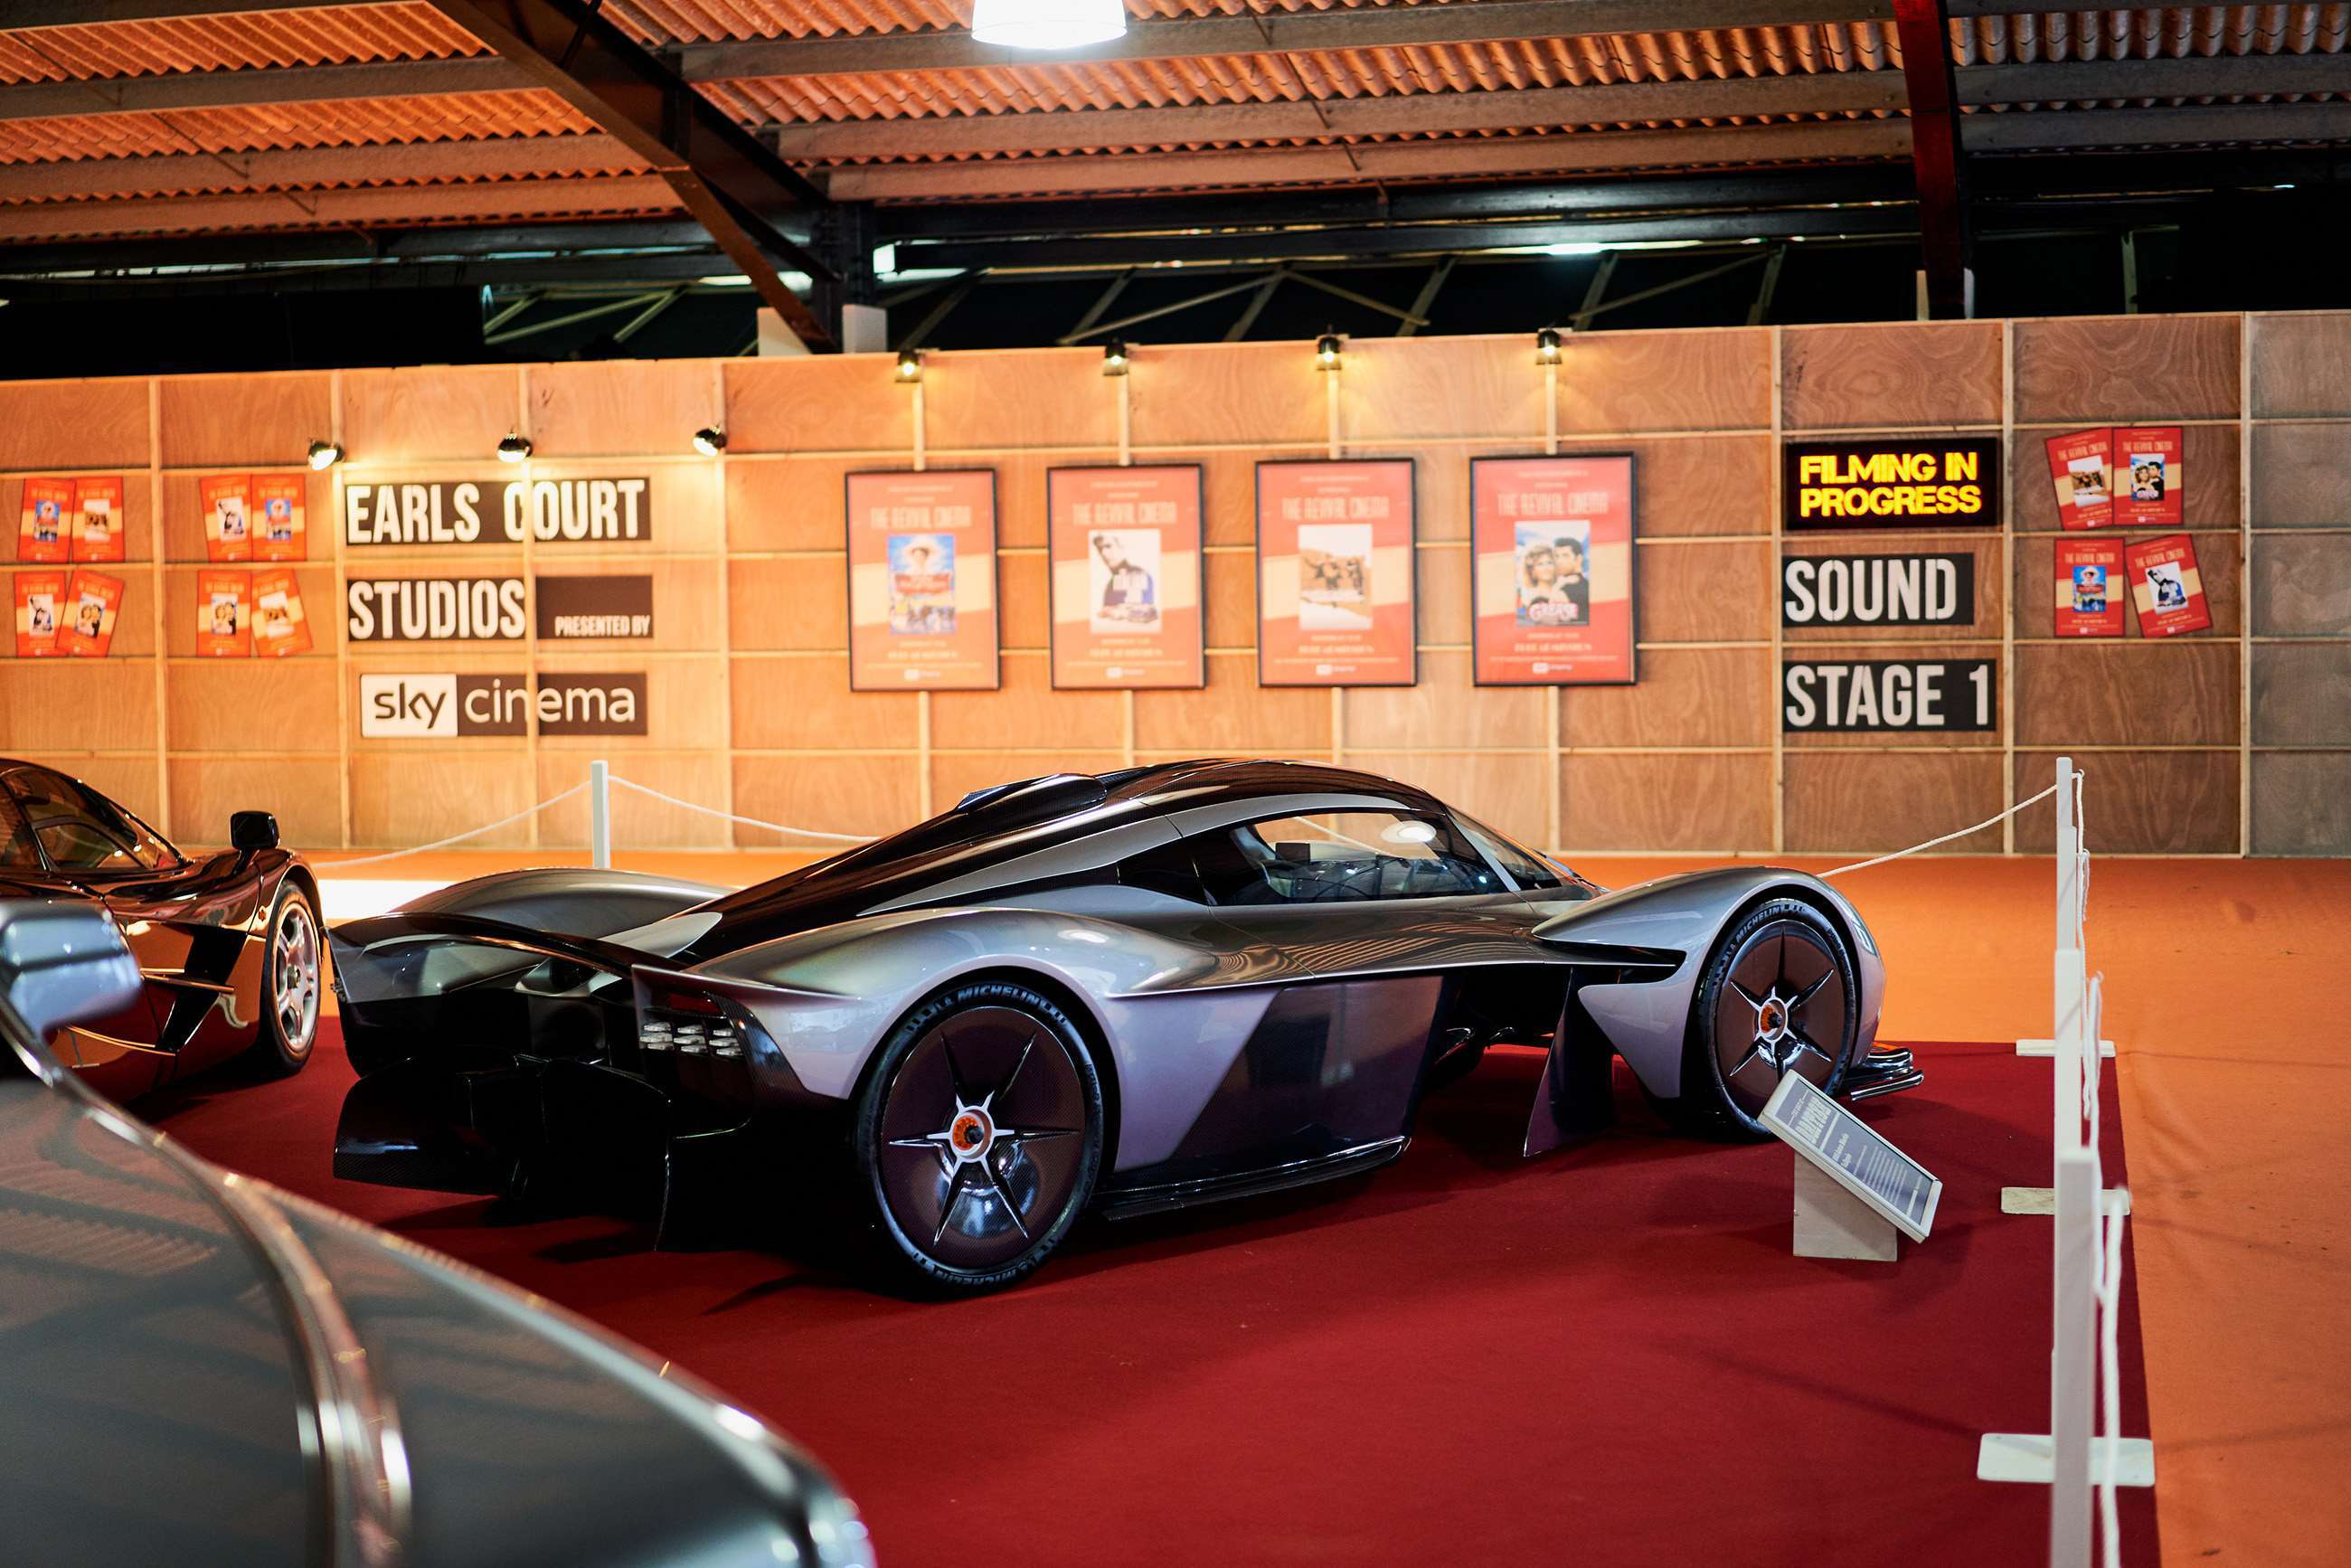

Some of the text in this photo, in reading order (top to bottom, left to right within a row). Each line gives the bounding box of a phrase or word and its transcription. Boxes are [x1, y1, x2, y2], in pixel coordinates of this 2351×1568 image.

[1799, 451, 1978, 485] FILMING IN
[346, 478, 646, 543] EARLS COURT
[1799, 485, 1983, 518] PROGRESS
[348, 579, 526, 639] STUDIOS
[1784, 559, 1957, 622] SOUND
[554, 615, 651, 637] PRESENTED BY
[373, 678, 636, 730] sky cinema
[1785, 664, 1988, 727] STAGE 1
[1735, 904, 1782, 942] MICHELIN
[957, 983, 1041, 1006] MICHELIN
